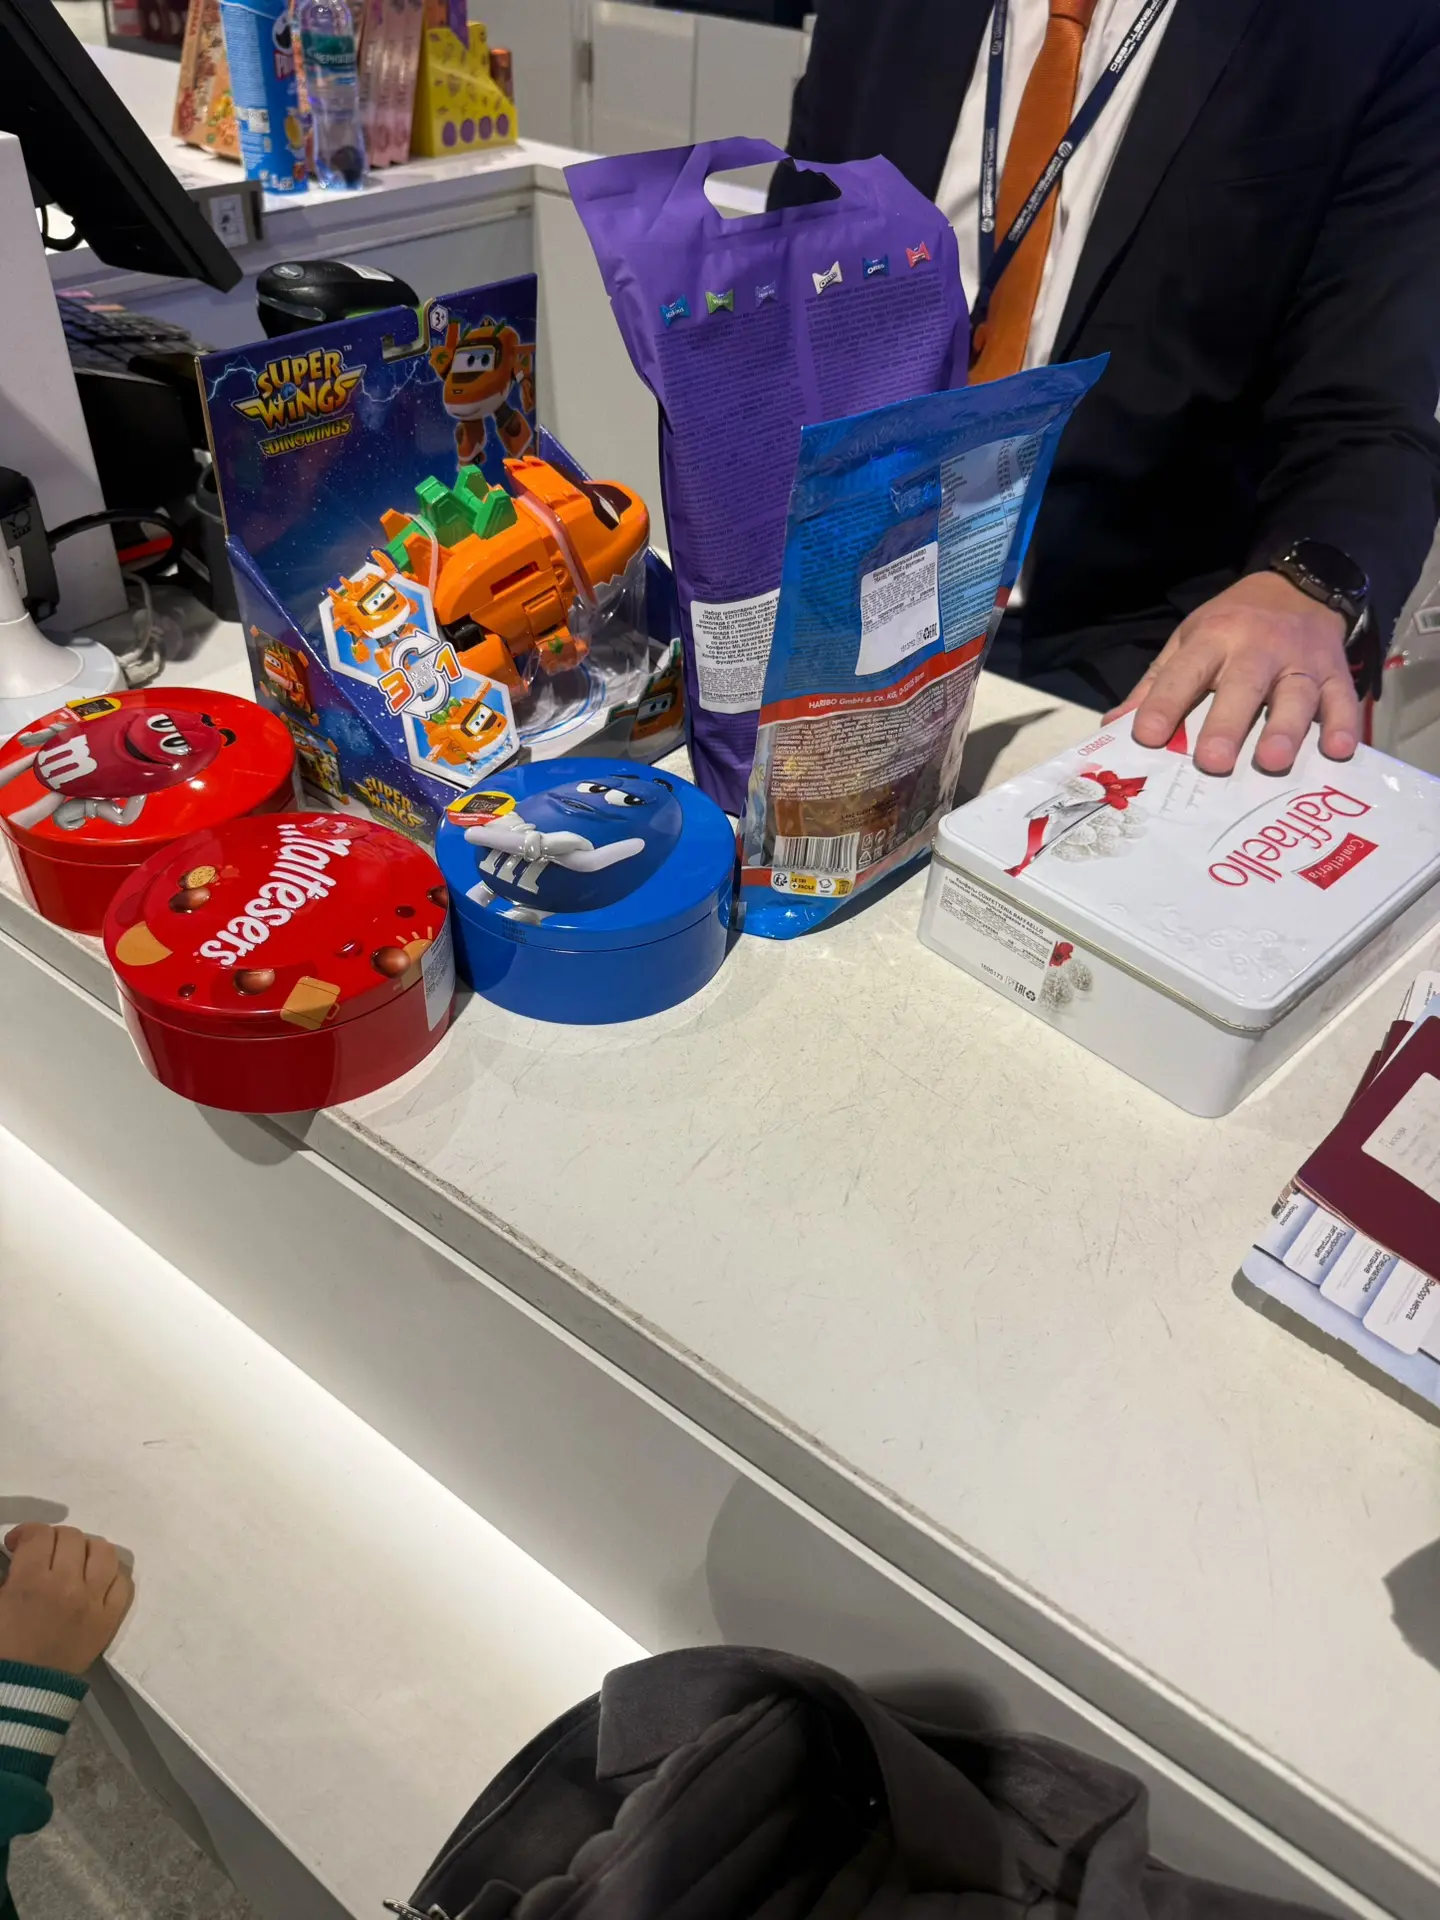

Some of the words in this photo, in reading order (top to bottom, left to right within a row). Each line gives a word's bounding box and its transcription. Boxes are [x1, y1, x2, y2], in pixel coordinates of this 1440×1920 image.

[1110, 0, 1161, 72] РЕМЕТЬЕВО
[256, 349, 342, 399] SUPER
[232, 366, 366, 431] WINGS
[264, 418, 352, 455] DINOWINGS
[913, 548, 927, 558] HARIBO
[722, 605, 757, 616] шоколадных
[758, 599, 775, 609] конфет
[737, 619, 763, 630] Конфеты
[702, 652, 727, 662] Конфеты
[705, 644, 731, 652] Конфеты
[716, 648, 737, 656] вкусом
[718, 639, 739, 647] вкусом
[420, 659, 433, 671] EN
[435, 647, 461, 681] 1
[379, 669, 412, 712] 3
[415, 675, 430, 689] EM
[808, 698, 838, 709] HARIBO
[839, 696, 864, 706] GmbH
[873, 694, 885, 703] Co.
[37, 734, 98, 790] m
[354, 781, 427, 830] WINGS
[364, 777, 413, 813] SUPER
[1207, 784, 1372, 887] Raffaello
[1308, 838, 1366, 880] Confetteria
[199, 824, 352, 966] Maltesers
[955, 877, 977, 894] Конфеты
[977, 890, 1012, 916] CONFETTERIA
[1013, 911, 1044, 935] RAFFAELLO
[1362, 1253, 1392, 1293] Специальное
[1363, 1248, 1383, 1274] питание
[1416, 1278, 1436, 1301] Выбор
[1405, 1297, 1425, 1321] места
